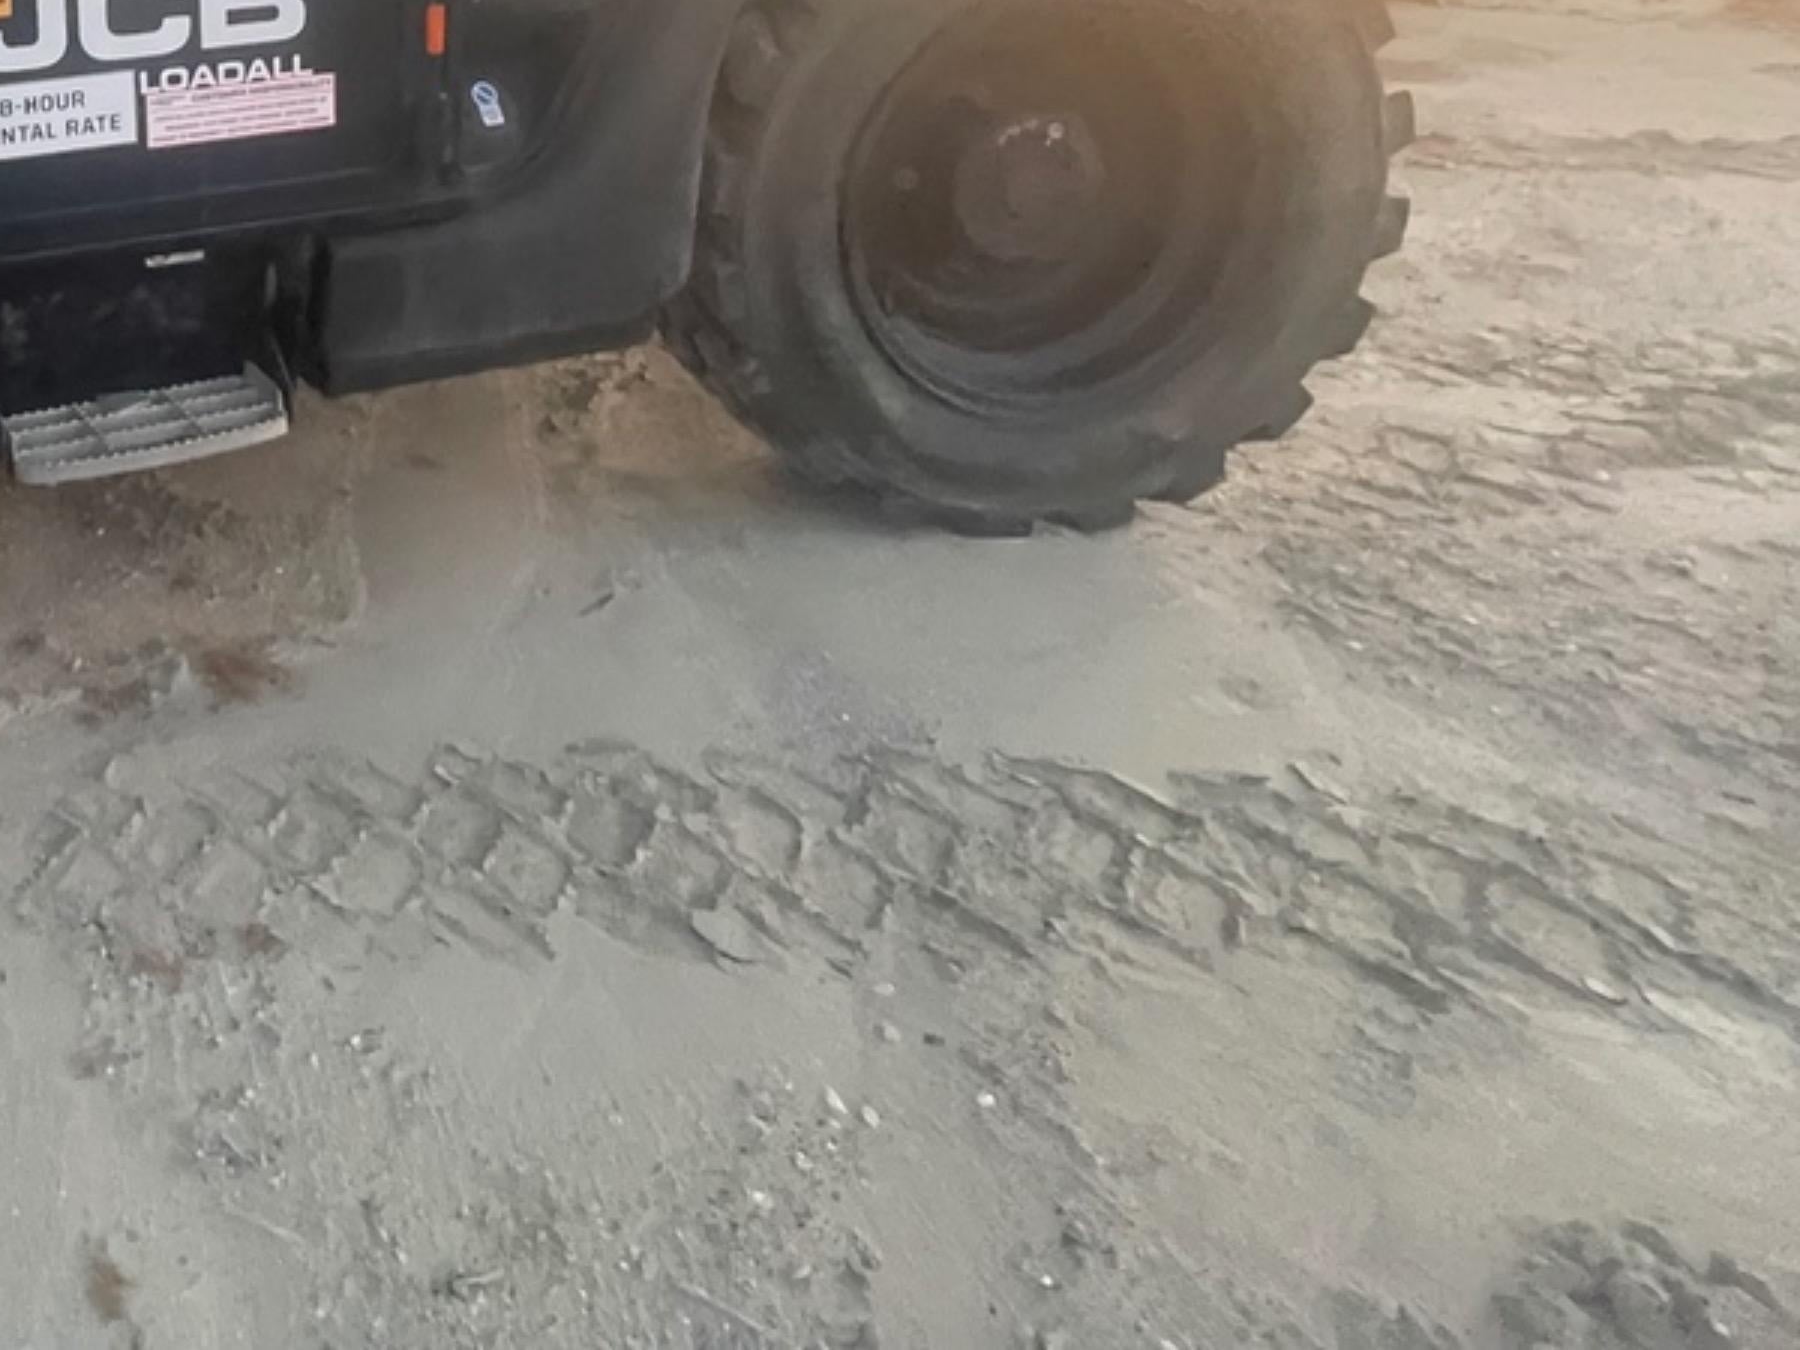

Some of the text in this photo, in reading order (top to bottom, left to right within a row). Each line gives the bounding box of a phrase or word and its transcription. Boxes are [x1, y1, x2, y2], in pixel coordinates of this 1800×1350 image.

[140, 53, 314, 95] LOADALL
[0, 89, 86, 118] 8-HOUR
[65, 113, 122, 137] RATE
